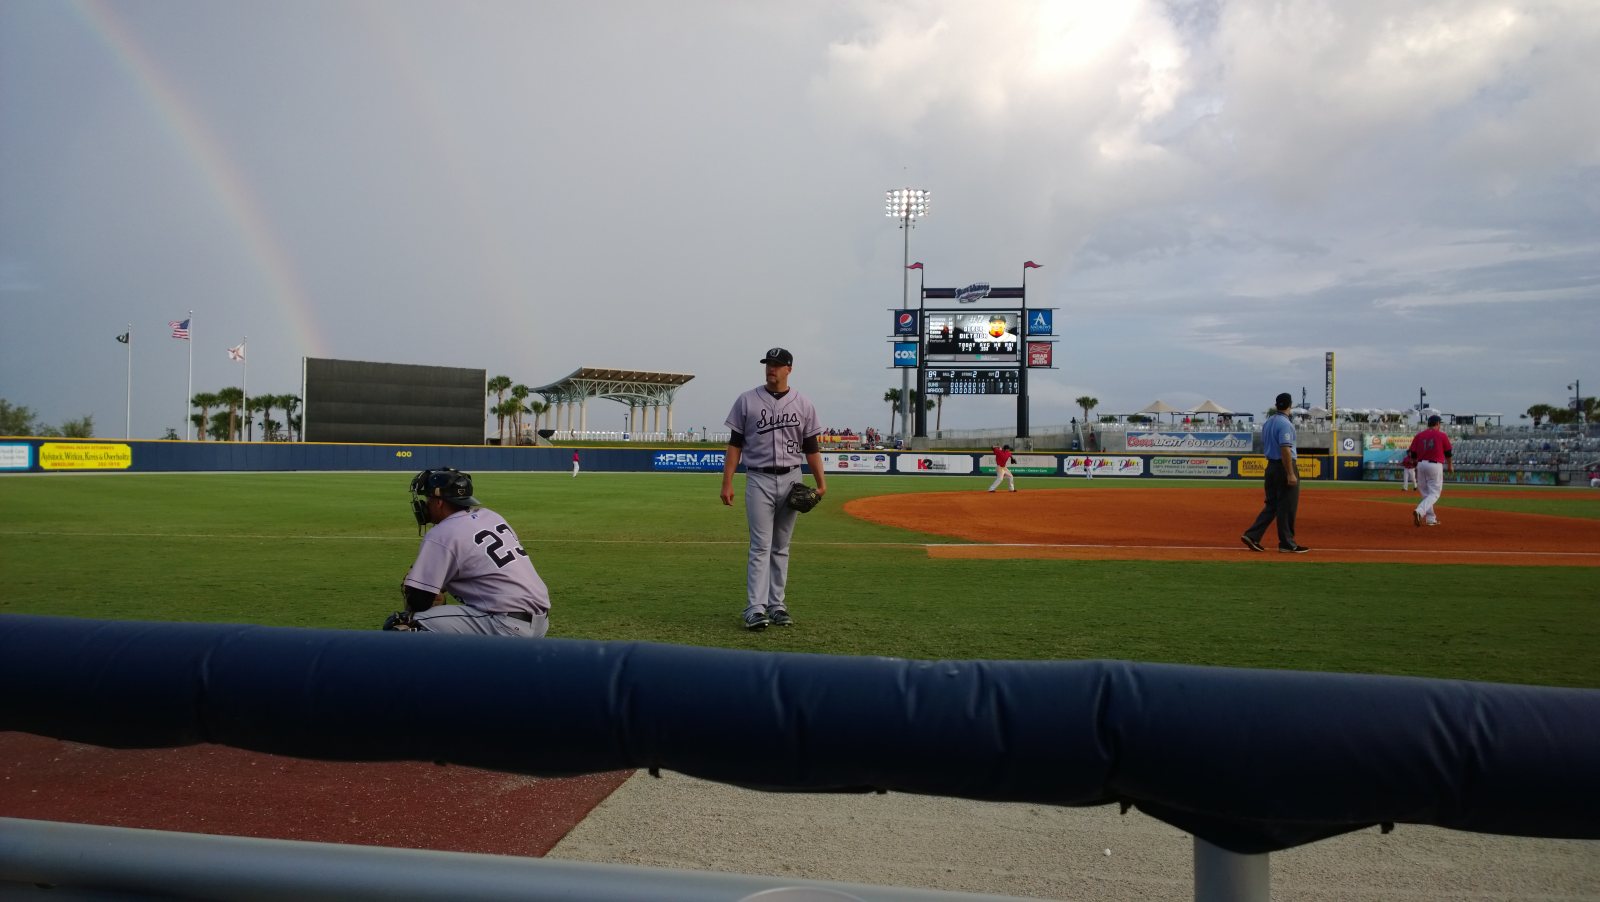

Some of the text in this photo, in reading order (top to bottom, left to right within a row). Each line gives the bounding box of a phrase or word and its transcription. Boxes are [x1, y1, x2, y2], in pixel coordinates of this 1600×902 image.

[928, 370, 937, 378] 89
[756, 409, 800, 429] Suns
[1153, 439, 1184, 447] LIGHT
[665, 454, 725, 463] PEN AIR
[918, 458, 932, 469] K2
[474, 523, 529, 568] 23
